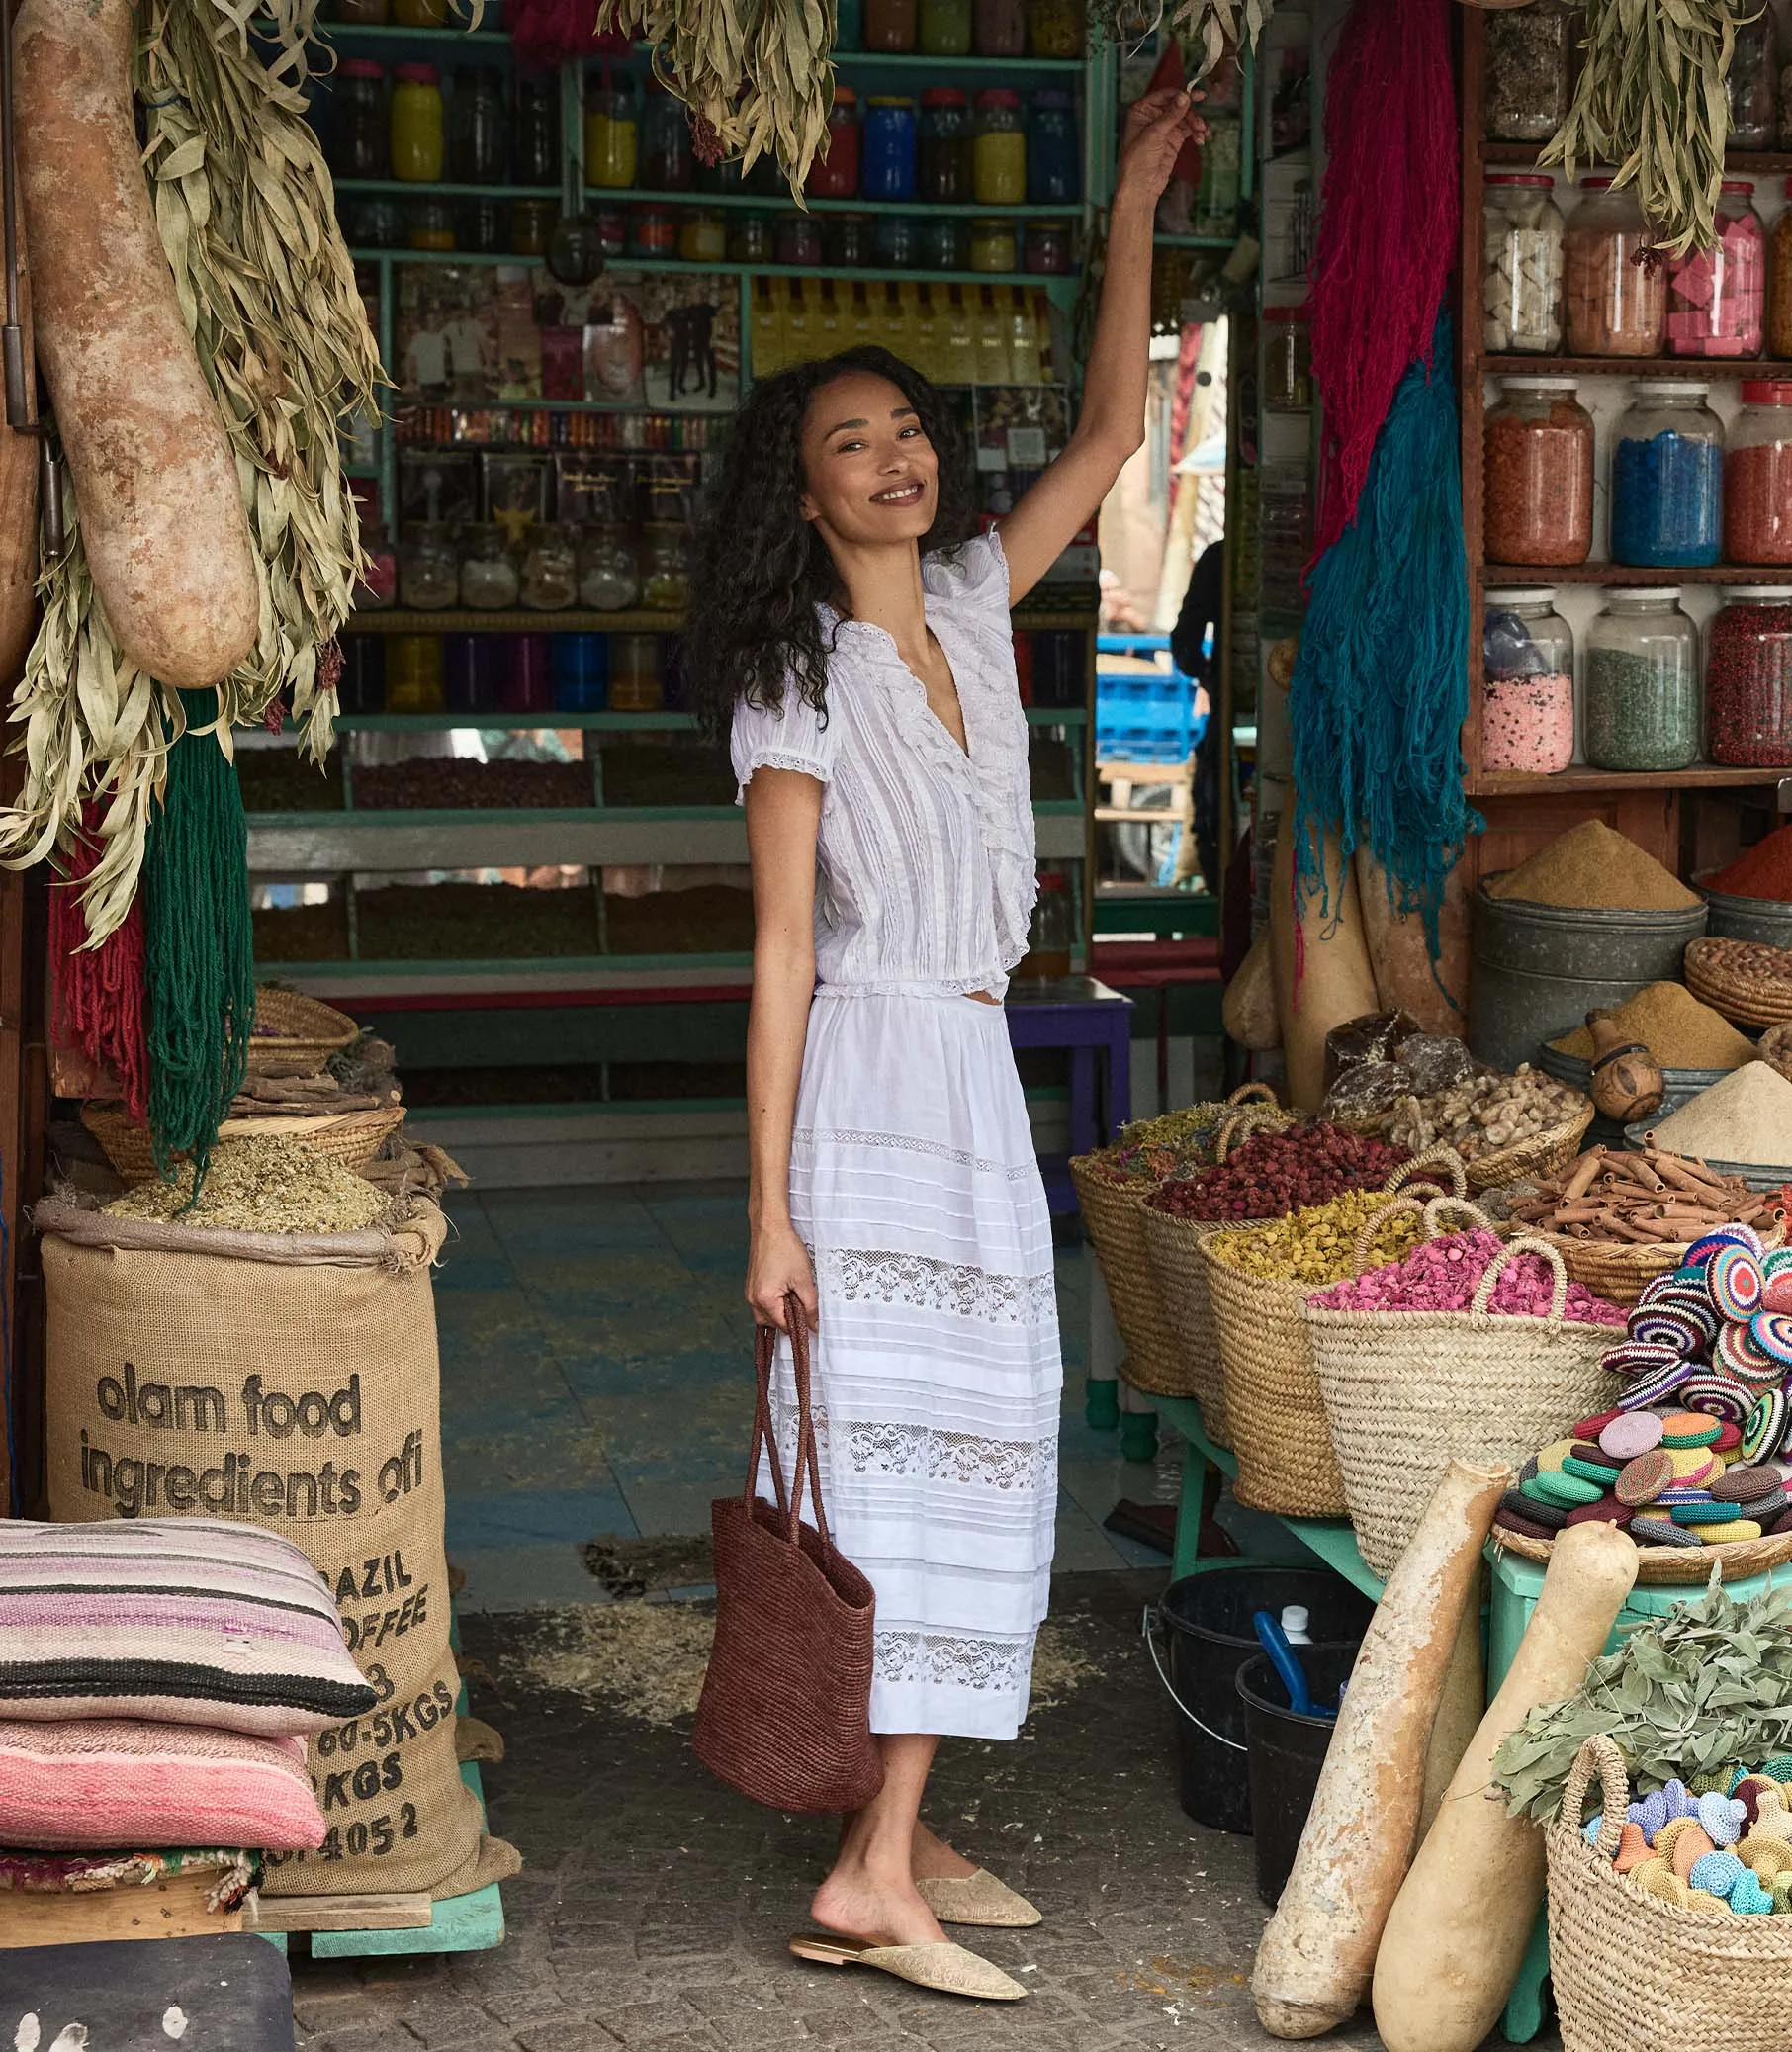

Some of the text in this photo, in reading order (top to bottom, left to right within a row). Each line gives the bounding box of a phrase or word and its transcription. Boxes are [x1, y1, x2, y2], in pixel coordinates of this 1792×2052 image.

[98, 1362, 361, 1439] olam food
[81, 1429, 422, 1518] ingredients ofi
[317, 1550, 412, 1604] AZIL
[312, 1752, 403, 1811] KGS
